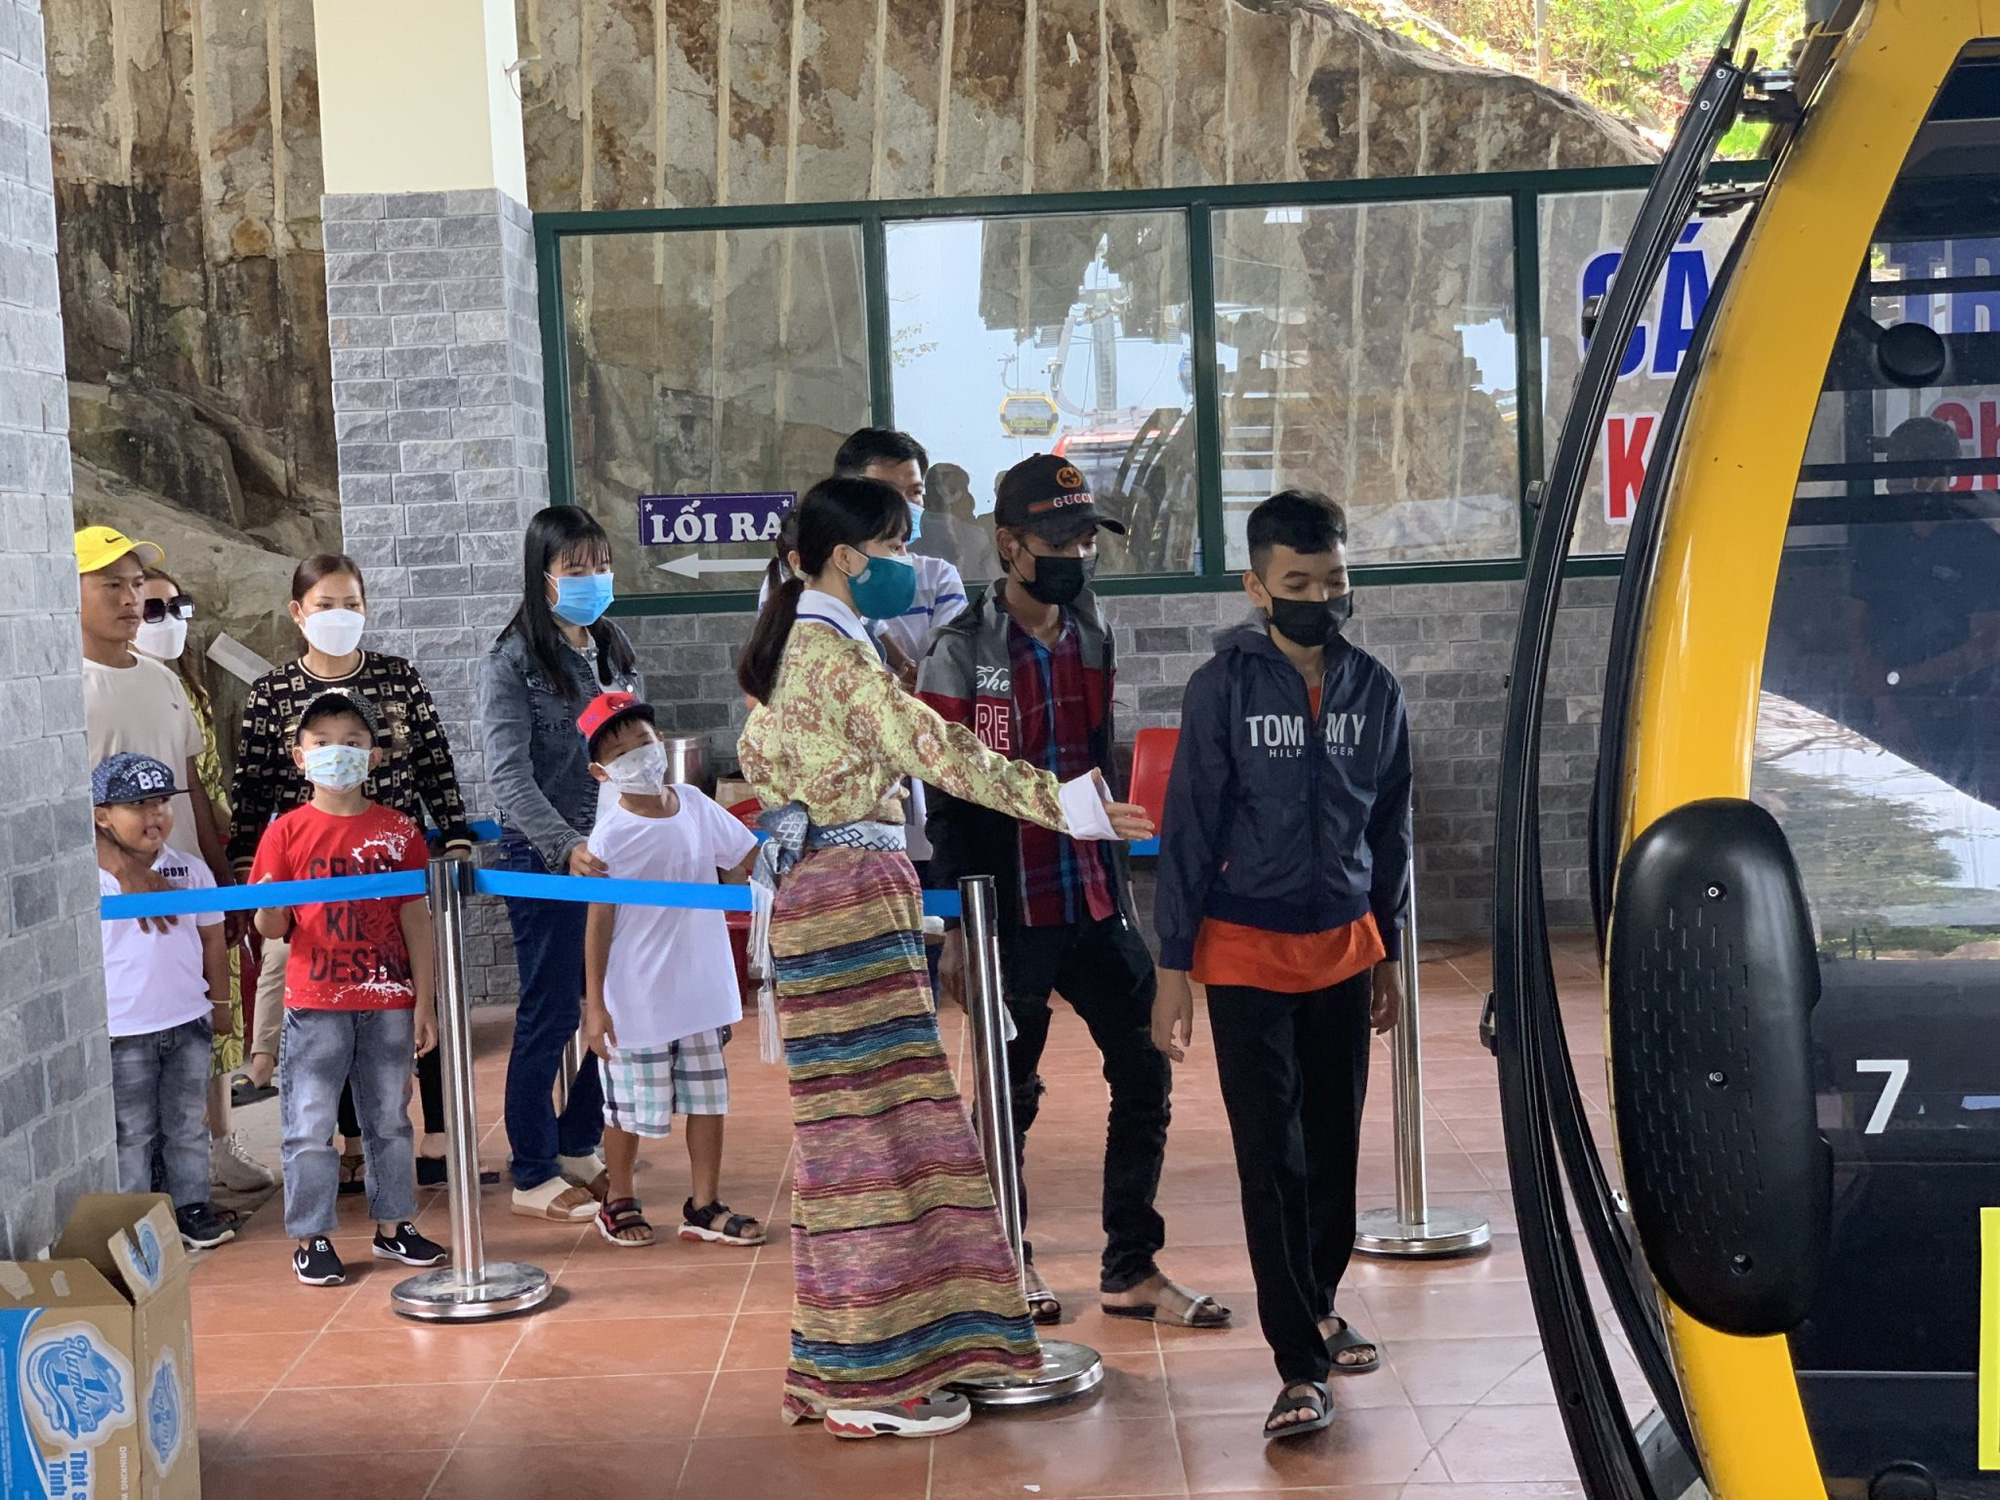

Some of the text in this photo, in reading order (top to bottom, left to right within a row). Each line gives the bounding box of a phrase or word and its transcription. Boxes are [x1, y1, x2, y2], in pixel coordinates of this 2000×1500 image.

[1053, 493, 1095, 508] GUCCI
[650, 500, 782, 543] LỐI RA
[976, 665, 1011, 692] The
[1245, 713, 1367, 747] TOMMY
[137, 770, 165, 790] B2
[1856, 1059, 1909, 1134] 7
[61, 1338, 101, 1429] Number
[68, 1450, 89, 1487] Thật
[119, 1446, 129, 1490] DRINKING
